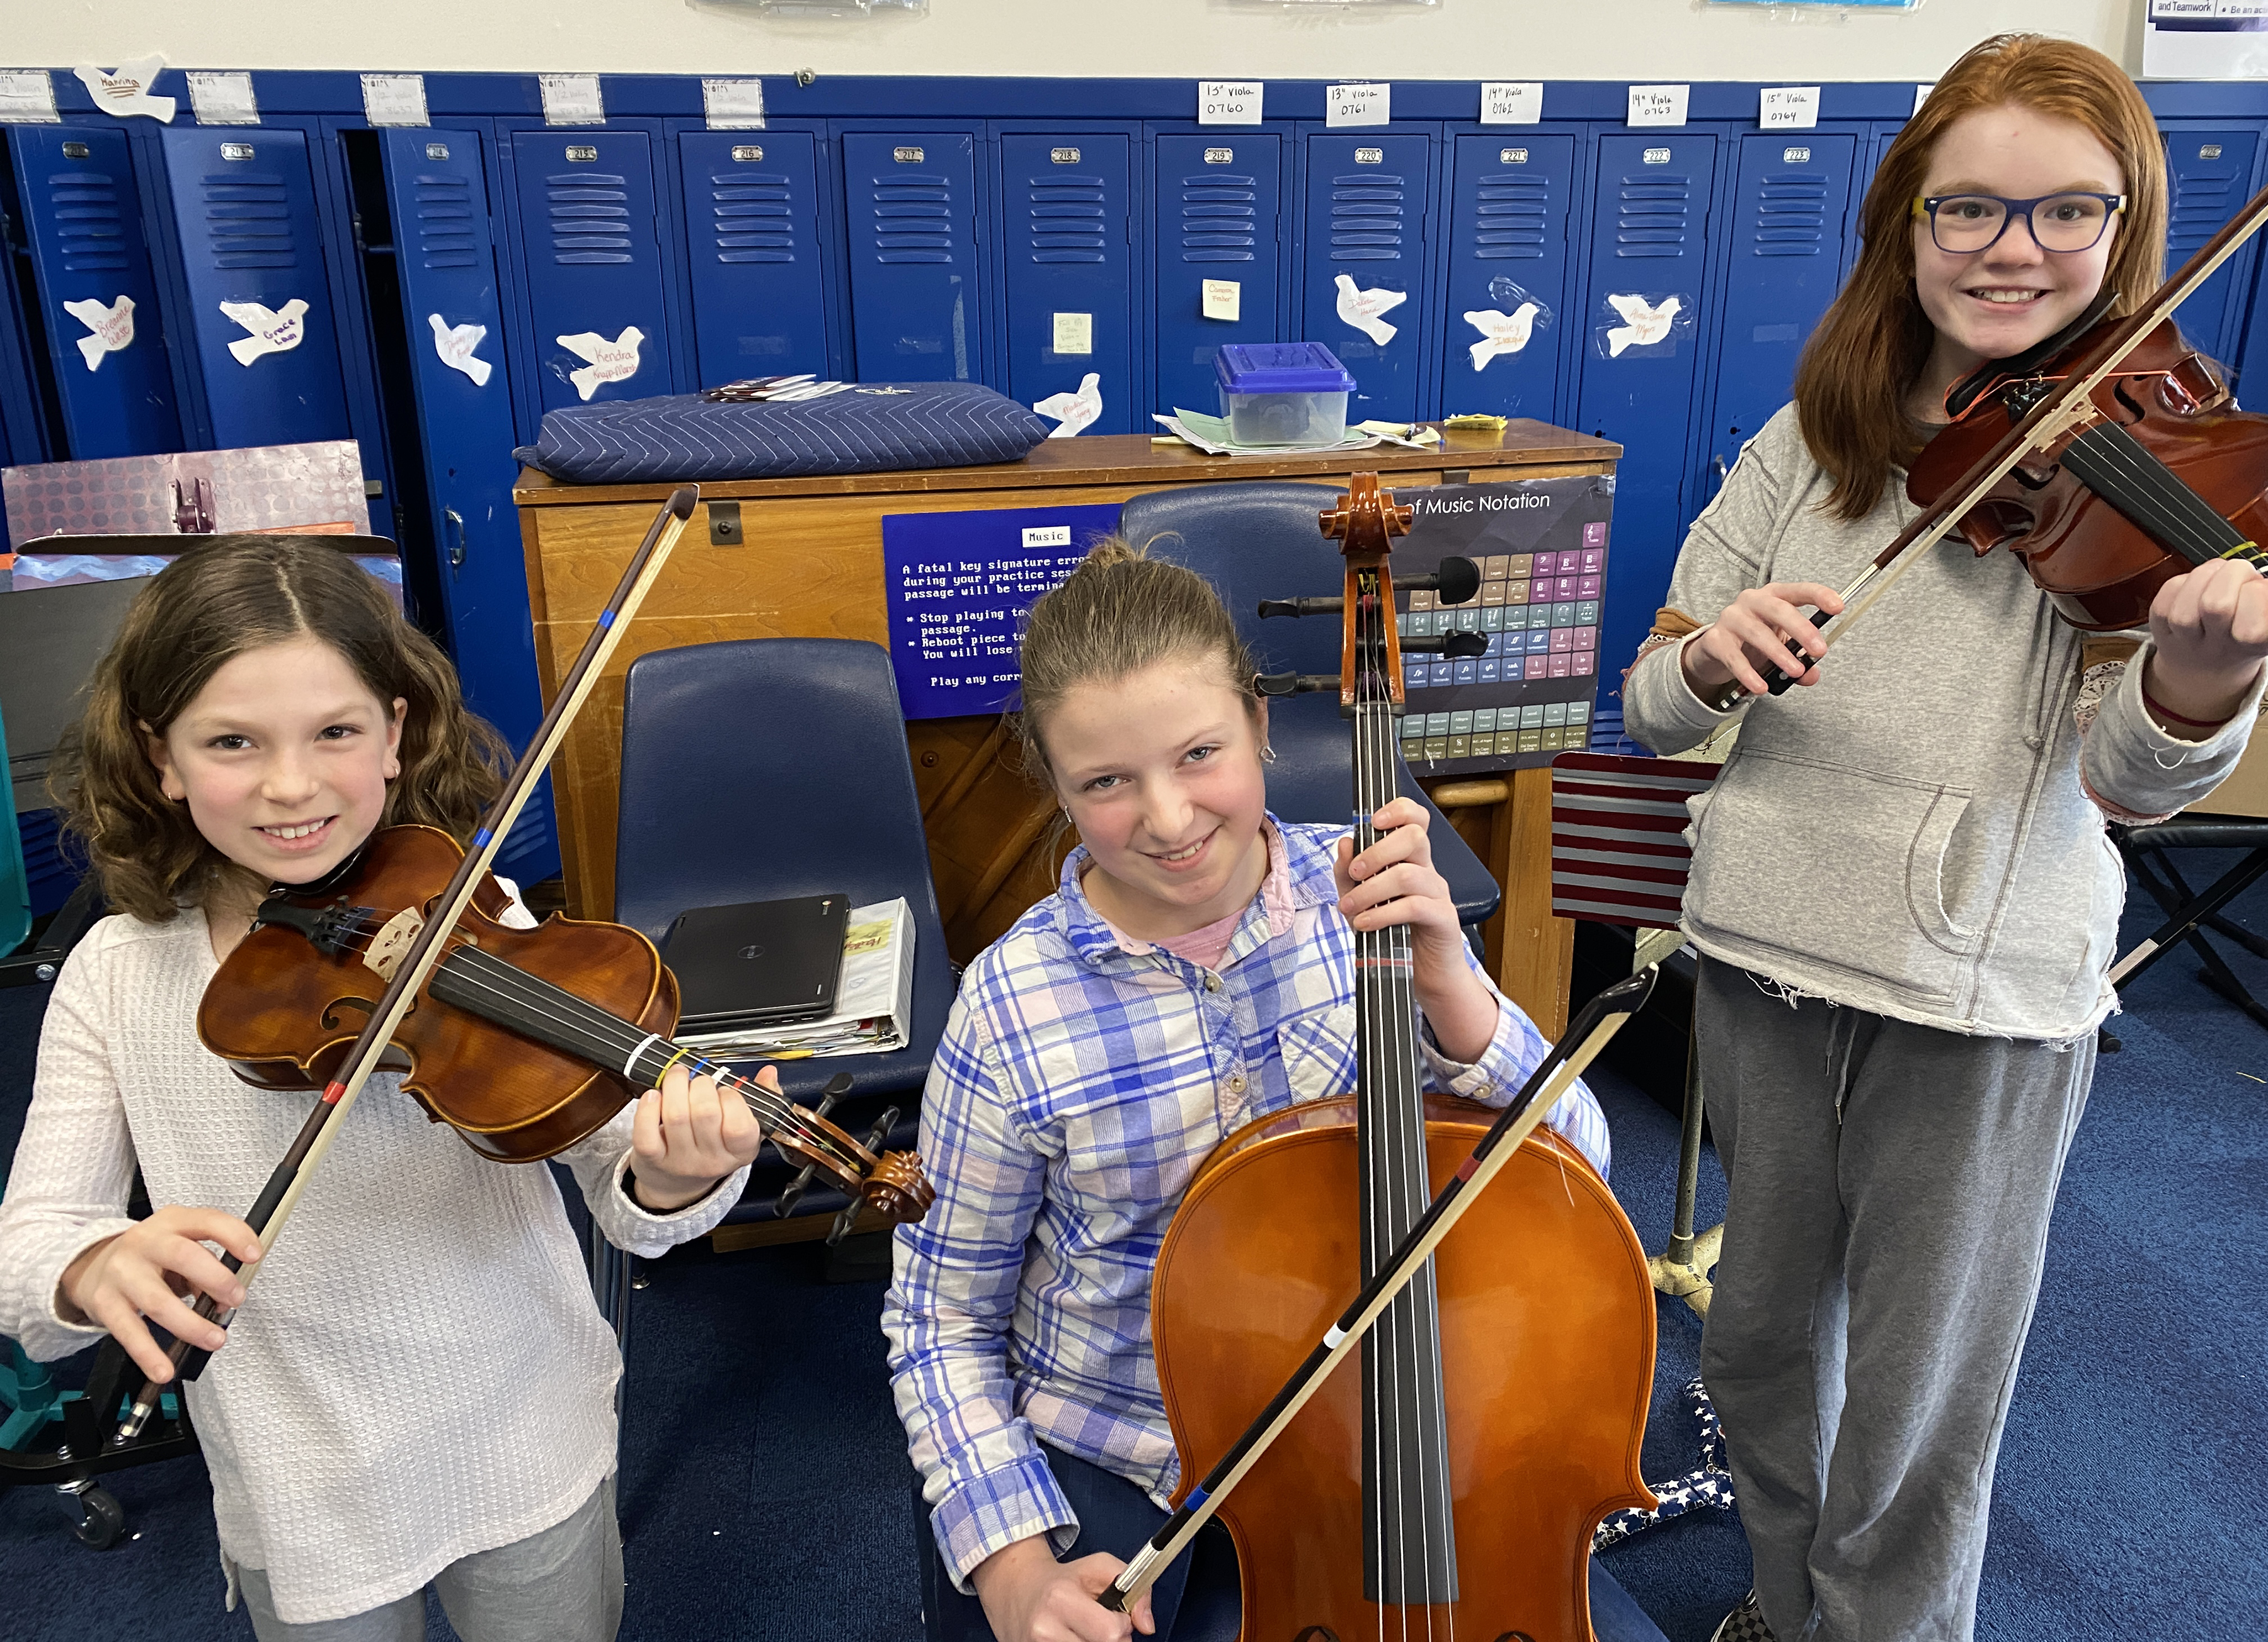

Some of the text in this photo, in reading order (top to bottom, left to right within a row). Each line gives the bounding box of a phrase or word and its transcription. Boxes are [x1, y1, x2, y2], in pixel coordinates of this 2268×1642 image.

[2158, 1, 2211, 11] and Teamwork
[1207, 85, 1223, 95] 13"
[1332, 88, 1346, 100] 13"
[1489, 86, 1521, 100] 14" Viola
[1632, 94, 1673, 106] 14" Viola
[1767, 93, 1807, 103] 15" Viola
[1207, 104, 1243, 113] 0760
[1341, 103, 1366, 115] 0761
[1645, 106, 1671, 115] 0763
[1771, 111, 1797, 122] 0764
[575, 149, 588, 157] 215
[263, 319, 295, 339] Grace
[1492, 322, 1520, 336] Hailey
[594, 346, 636, 363] Kendra
[1425, 496, 1474, 514] Music
[1479, 493, 1550, 511] Notation
[1029, 532, 1063, 542] Music
[902, 557, 1085, 574] A fatal key signature erro
[903, 576, 946, 587] during
[953, 575, 982, 585] your
[988, 570, 1045, 583] practice
[904, 581, 1065, 601] passage will be termina
[920, 608, 1025, 624] Stop playing to
[921, 625, 976, 637] passage.
[922, 632, 1026, 647] Reboot piece to
[923, 650, 944, 659] You
[951, 647, 977, 657] will
[987, 646, 1012, 655] lose
[931, 673, 1023, 687] Play any corr
